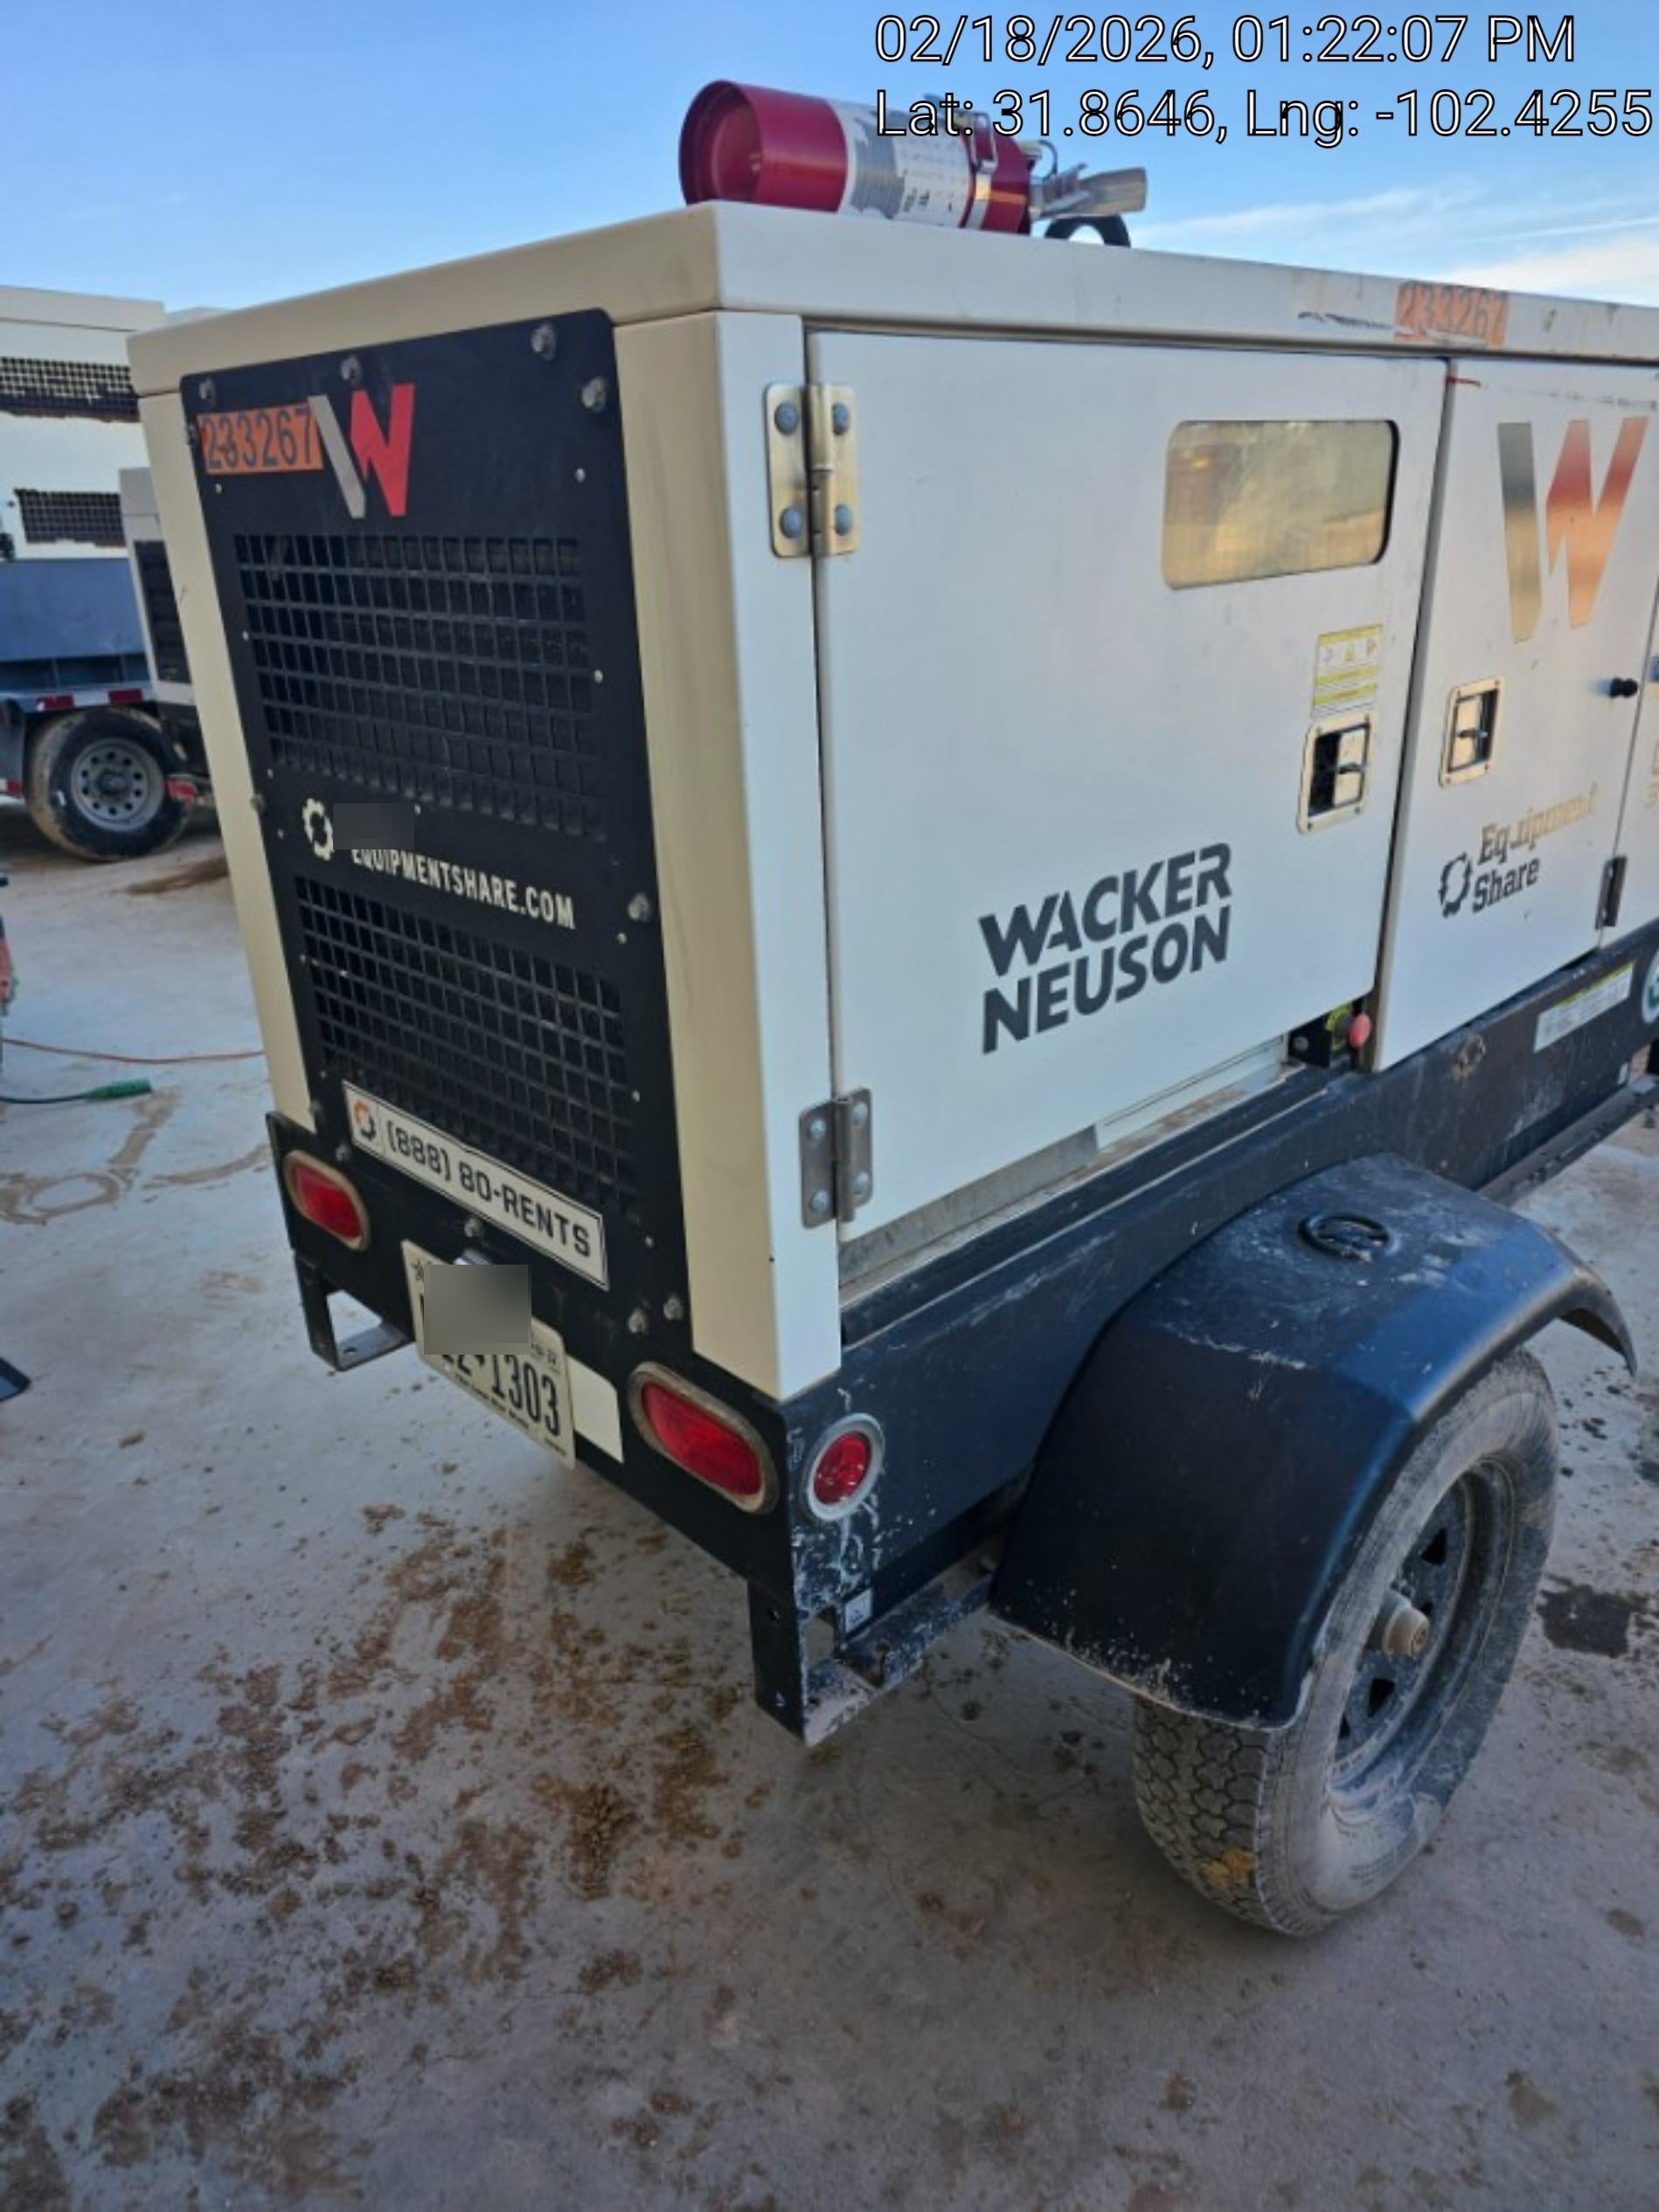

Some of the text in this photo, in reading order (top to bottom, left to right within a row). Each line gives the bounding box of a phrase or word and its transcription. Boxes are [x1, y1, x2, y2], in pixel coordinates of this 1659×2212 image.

[201, 406, 315, 471] 233267
[977, 842, 1232, 978] WACKER
[1472, 856, 1540, 914] Share
[982, 904, 1232, 1056] NEUSON
[386, 1120, 592, 1259] (888) 80-RENTS
